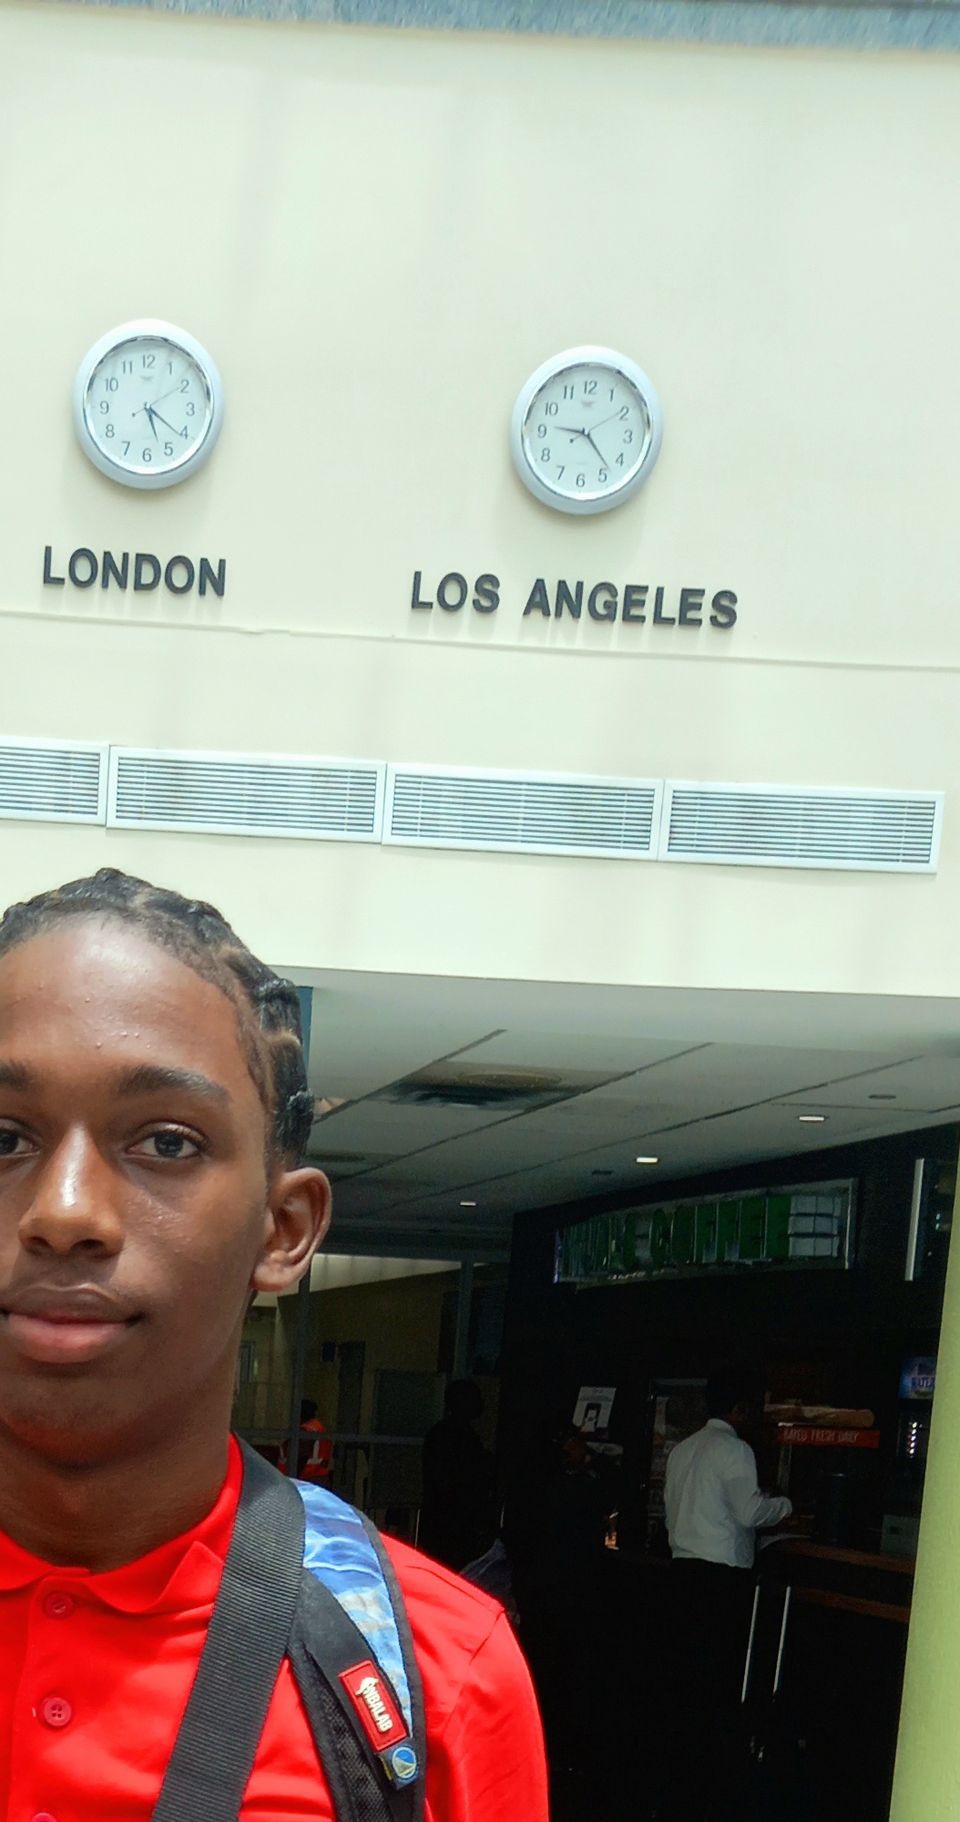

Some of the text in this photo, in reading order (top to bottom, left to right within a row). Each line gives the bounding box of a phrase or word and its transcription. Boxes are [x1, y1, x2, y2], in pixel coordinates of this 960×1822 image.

[122, 360, 133, 374] 11
[142, 354, 156, 369] 12
[105, 377, 119, 392] 10
[180, 379, 190, 393] 2
[584, 380, 598, 395] 12
[563, 385, 574, 400] 11
[100, 400, 109, 415] 9
[186, 402, 195, 416] 3
[545, 402, 559, 416] 10
[619, 406, 629, 420] 2
[105, 423, 115, 438] 8
[180, 425, 188, 440] 4
[537, 424, 547, 438] 9
[623, 429, 633, 444] 3
[121, 441, 130, 456] 7
[142, 448, 152, 462] 6
[164, 442, 173, 456] 5
[540, 447, 550, 462] 8
[615, 452, 624, 466] 4
[556, 465, 565, 480] 7
[576, 473, 585, 487] 6
[598, 468, 607, 482] 5
[43, 545, 226, 597] LONDON
[410, 571, 738, 630] LOS ANGELES
